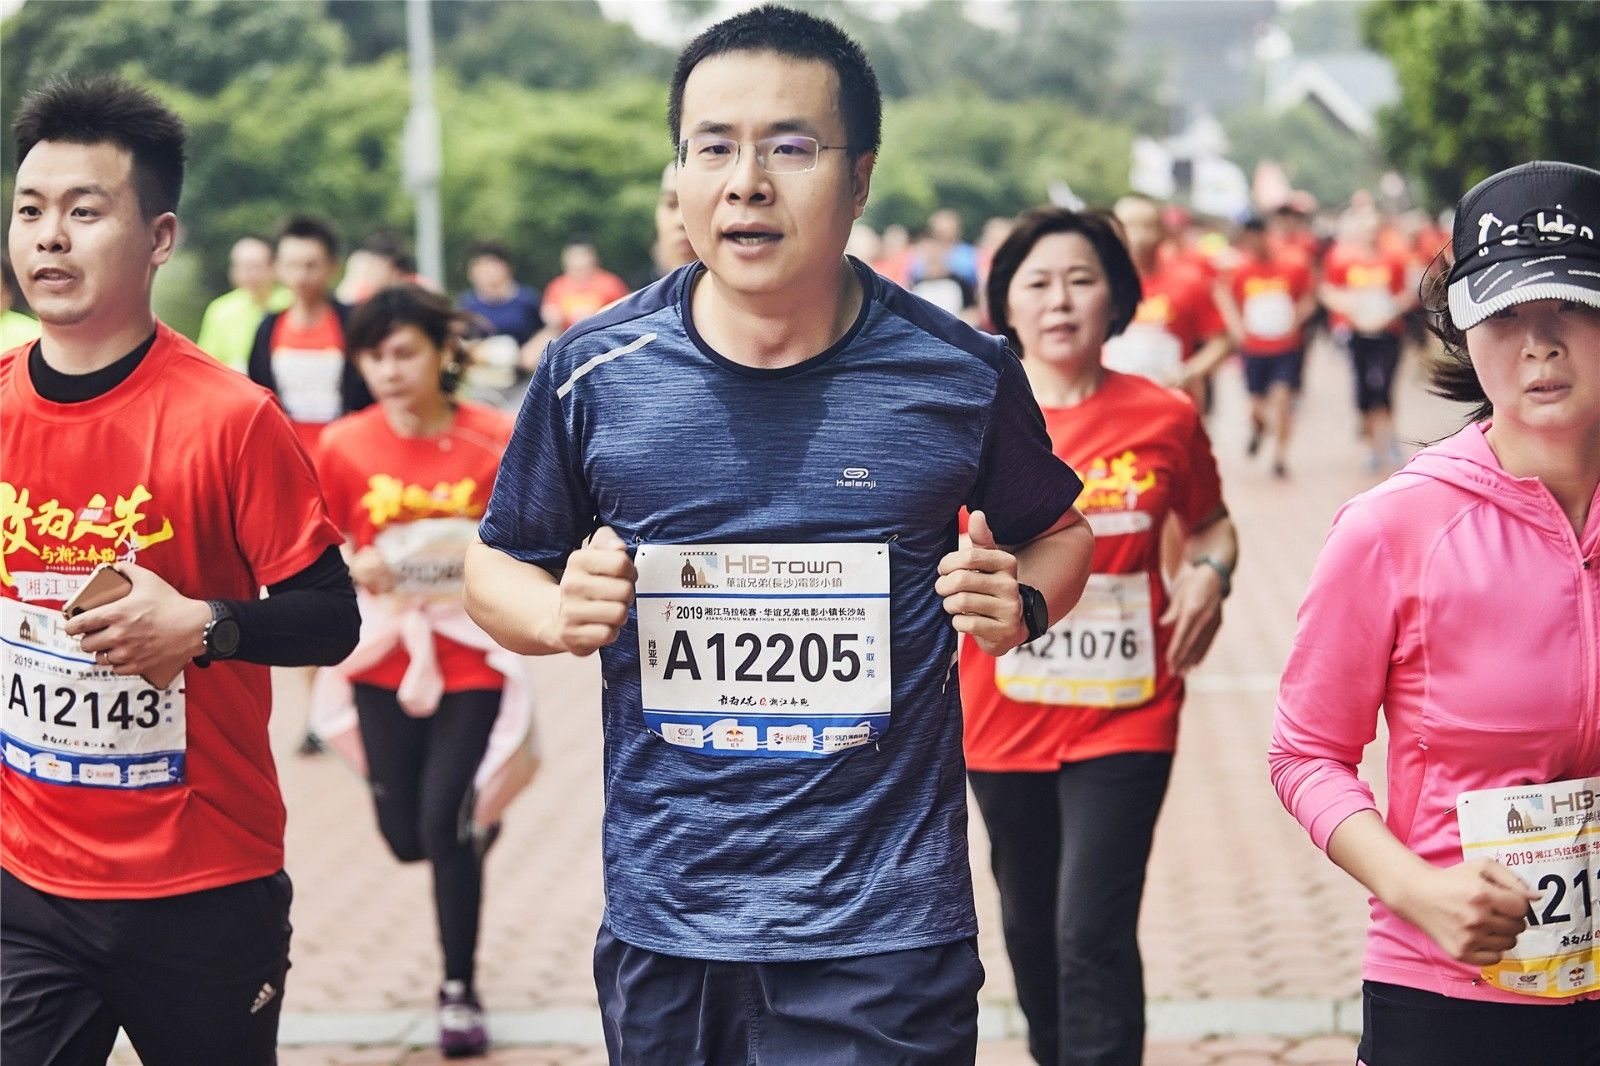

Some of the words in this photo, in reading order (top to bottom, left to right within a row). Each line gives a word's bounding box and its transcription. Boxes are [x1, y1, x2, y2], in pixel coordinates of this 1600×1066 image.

[676, 606, 703, 620] 2019
[663, 630, 860, 682] A12205
[8, 672, 160, 730] A12143
[1550, 789, 1600, 814] HB
[1505, 850, 1534, 867] 2019
[1525, 868, 1600, 927] 21
